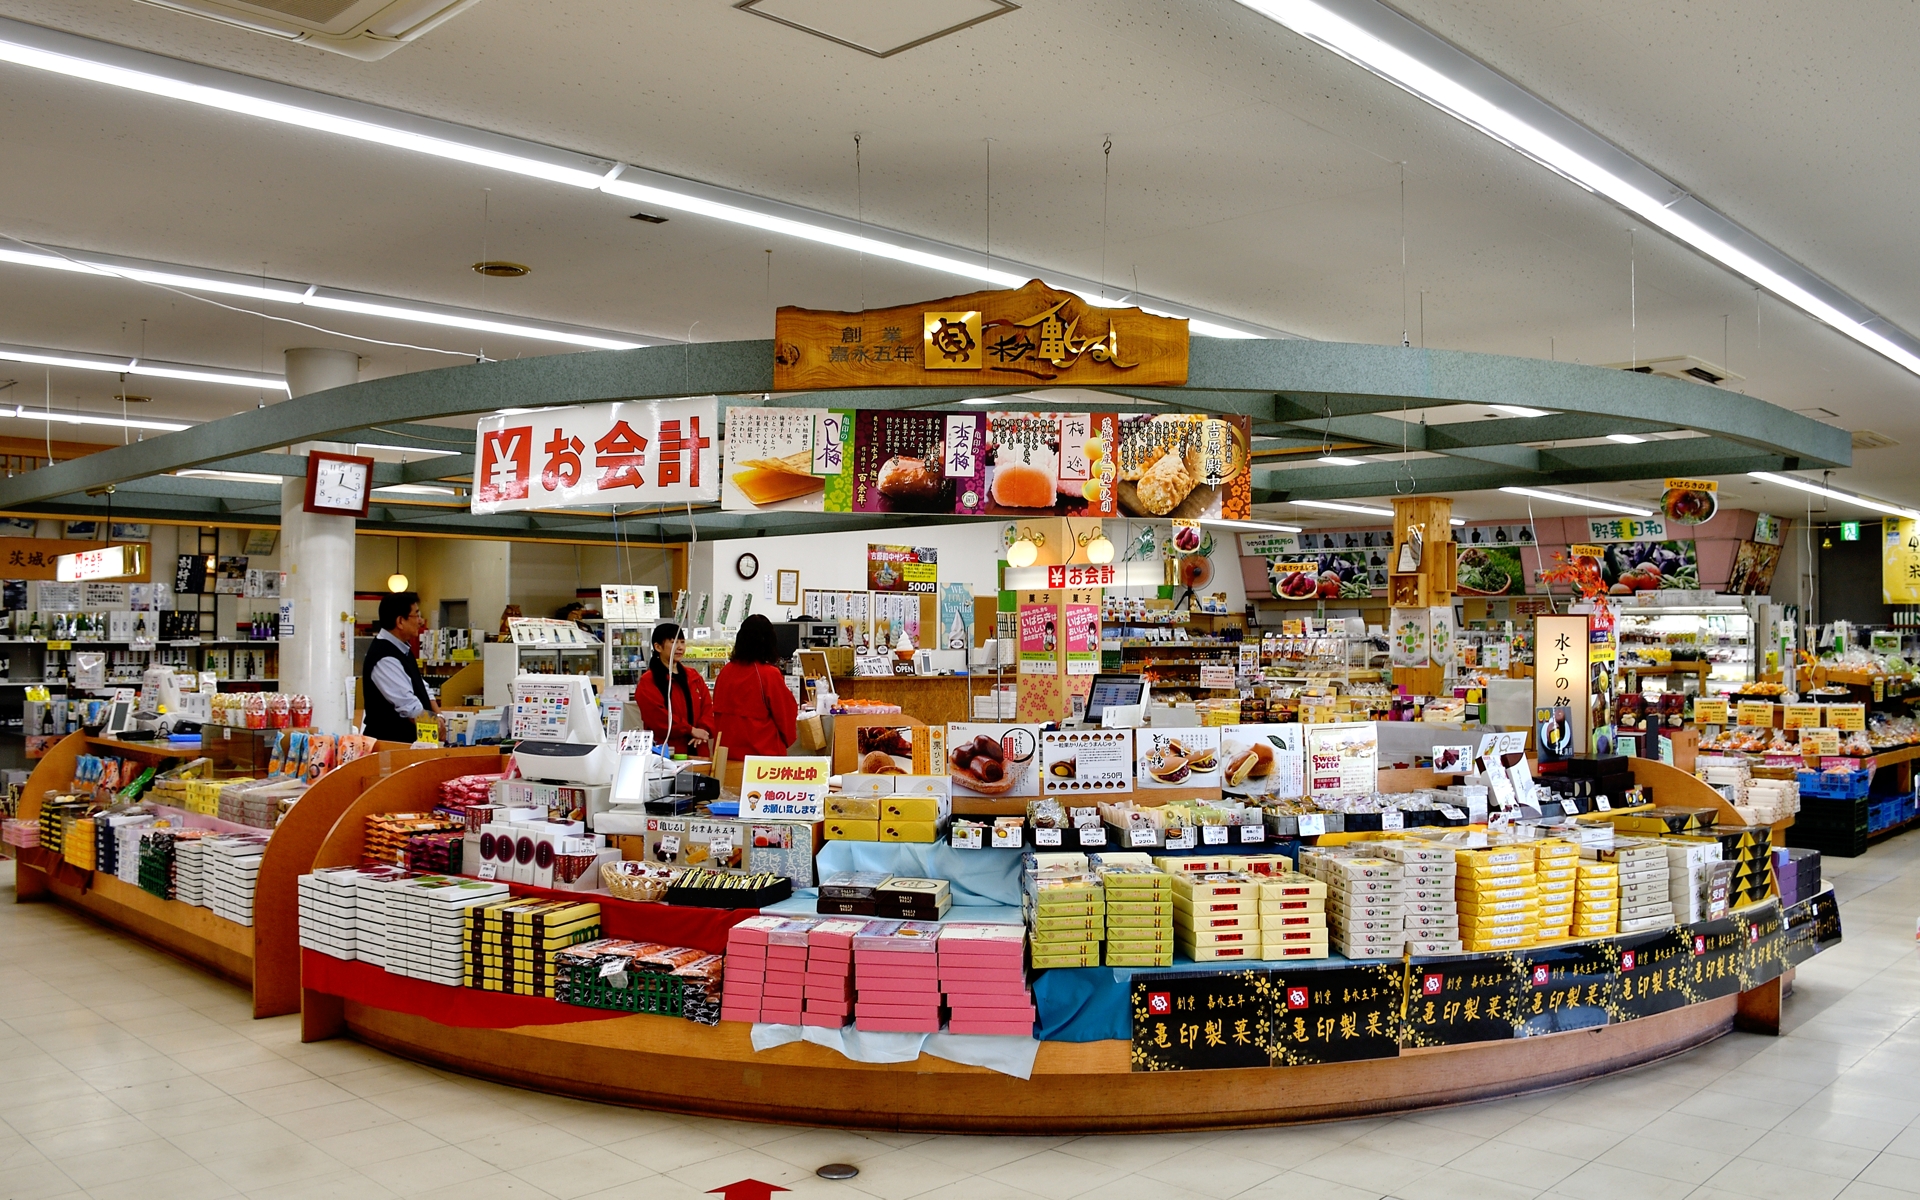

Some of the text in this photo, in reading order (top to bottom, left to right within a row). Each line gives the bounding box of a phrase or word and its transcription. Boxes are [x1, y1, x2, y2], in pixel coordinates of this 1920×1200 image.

[828, 344, 915, 363] 嘉永五年
[839, 416, 850, 440] 亀印の
[730, 415, 738, 465] 上品な味わいです。
[815, 418, 843, 469] のし梅
[972, 431, 982, 454] 亀印の
[1065, 421, 1085, 474] 梅一途
[541, 416, 709, 491] お会計
[1204, 422, 1222, 492] 吉原殿中
[1591, 520, 1663, 538] 野菜日和
[1069, 565, 1115, 585] お会計
[908, 582, 935, 592] 500円
[951, 585, 963, 594] WE
[1021, 613, 1057, 627] いばらきは
[1067, 613, 1098, 627] いばらきは
[895, 665, 913, 673] OPEN
[932, 741, 941, 773] 栗ひとつ
[1312, 754, 1341, 763] Sweet
[756, 766, 818, 781] レジ休止中
[659, 821, 685, 832] 亀じるし
[690, 824, 736, 835] 創業嘉永五年
[1154, 1017, 1251, 1049] 亀印製菓
